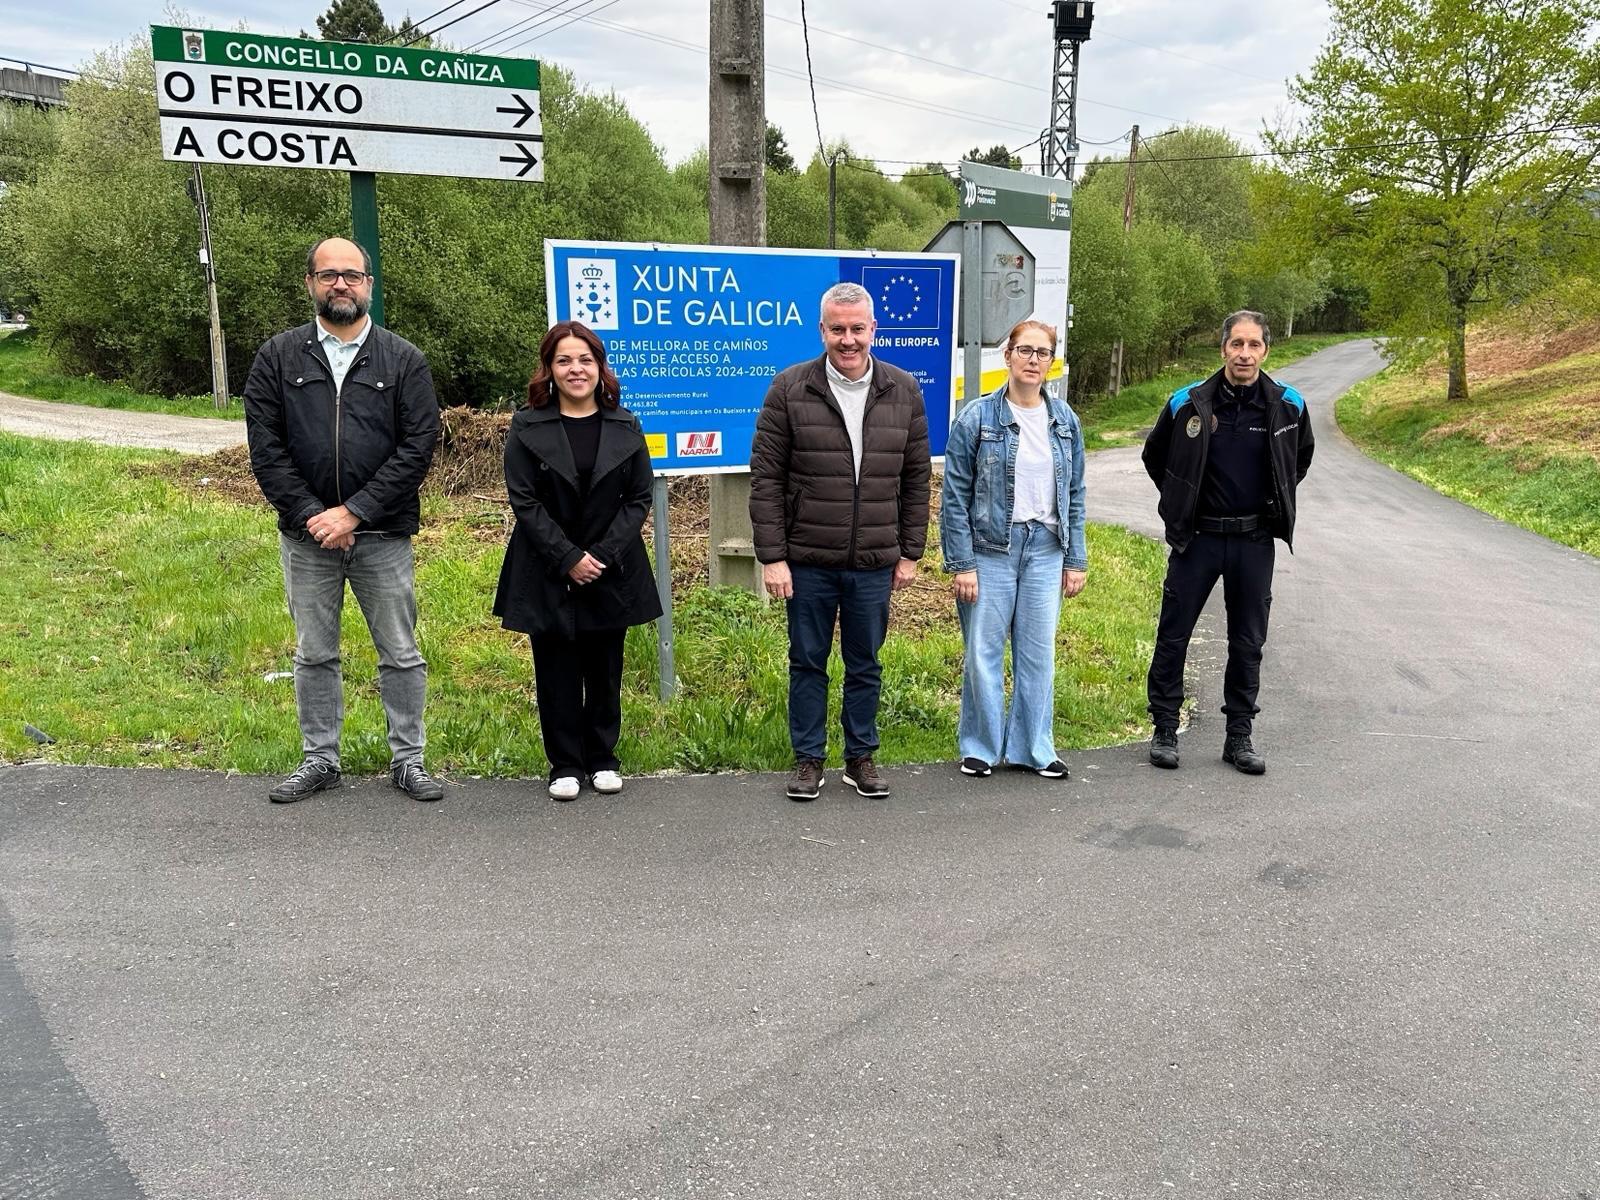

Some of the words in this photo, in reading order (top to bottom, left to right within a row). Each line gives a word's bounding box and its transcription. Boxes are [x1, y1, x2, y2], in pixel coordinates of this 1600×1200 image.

[225, 41, 362, 72] CONCELLO
[375, 55, 409, 76] DA
[420, 58, 505, 83] CAÑIZA
[163, 71, 195, 102] O
[210, 74, 363, 114] FREIXO
[173, 126, 204, 157] A
[217, 128, 358, 166] COSTA
[632, 265, 741, 293] XUNTA
[632, 299, 673, 325] DE
[683, 299, 803, 326] GALICIA
[610, 340, 627, 351] DE
[631, 340, 690, 351] MELLORA
[694, 340, 709, 351] DE
[714, 338, 768, 351] CAMIÑOS
[871, 336, 892, 347] NIÓN
[895, 337, 940, 347] EUROPEA
[606, 353, 646, 364] CIPAIS
[650, 353, 667, 364] DE
[670, 353, 719, 364] ACCESO
[722, 353, 731, 364] A
[641, 364, 711, 378] AGRÍCOLAS
[716, 366, 776, 377] 2024-2025
[679, 448, 719, 456] NAROM
